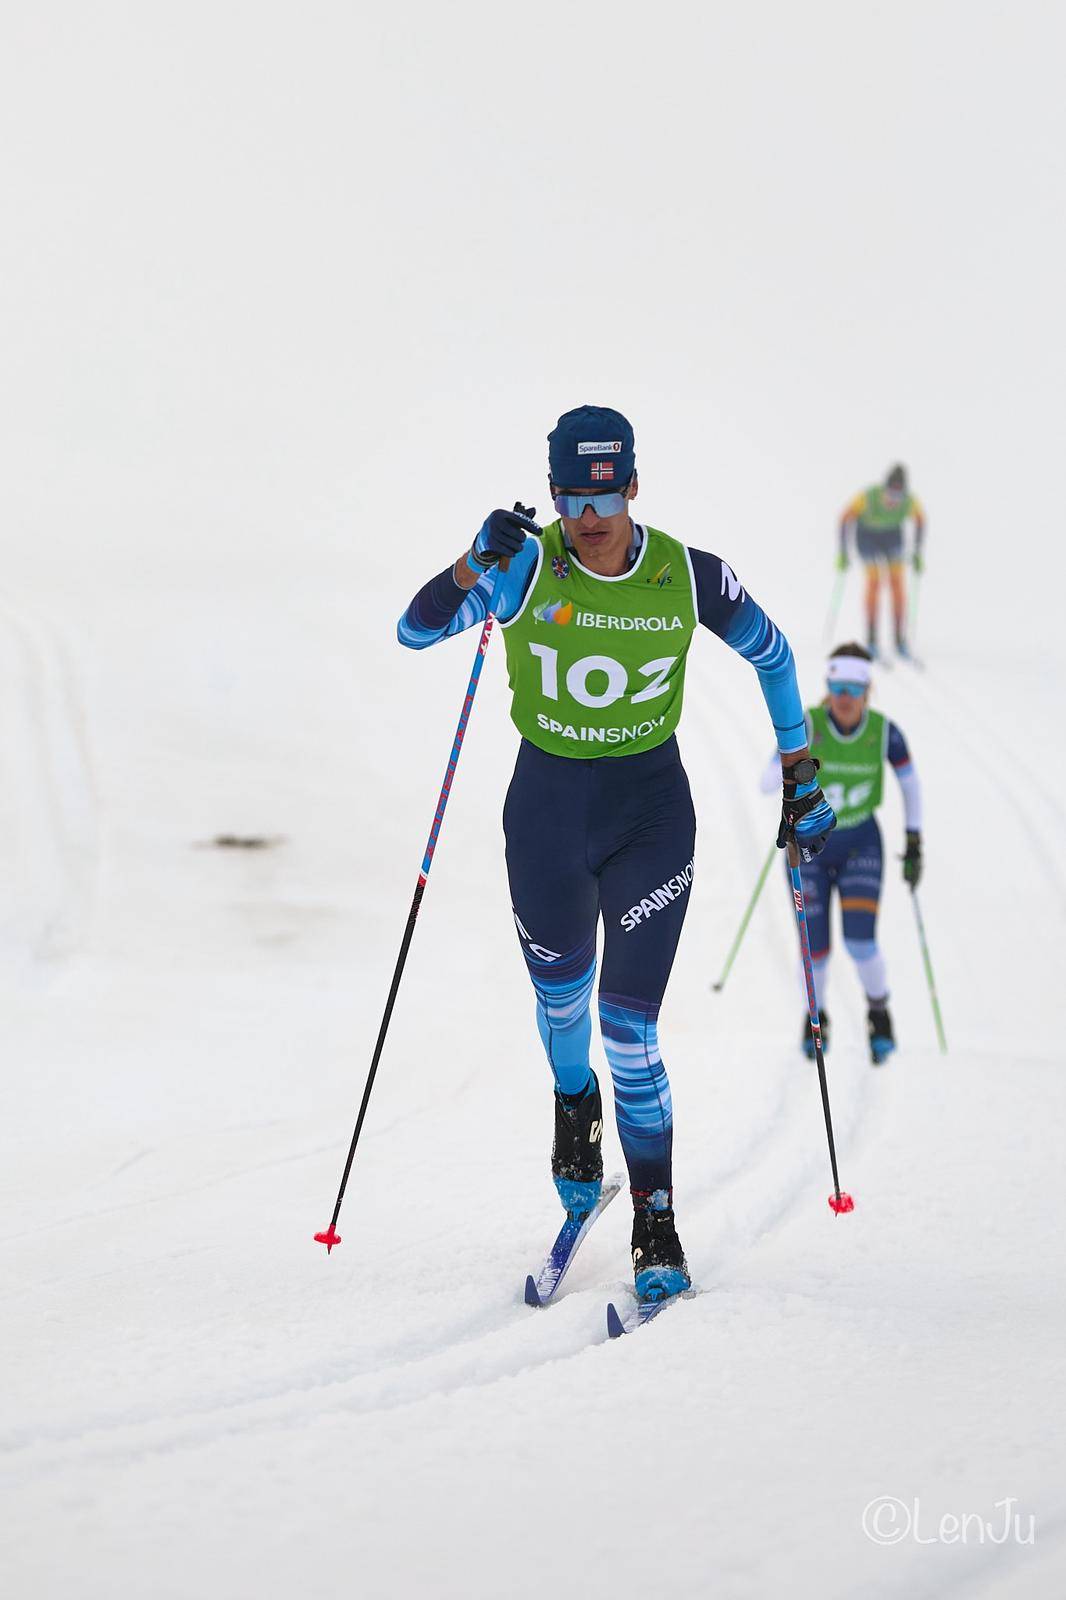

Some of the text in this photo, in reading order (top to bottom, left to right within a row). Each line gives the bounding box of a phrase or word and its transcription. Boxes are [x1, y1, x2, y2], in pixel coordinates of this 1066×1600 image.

[579, 444, 612, 453] SpareBank
[575, 611, 684, 631] IBERDROLA
[528, 641, 679, 709] 102
